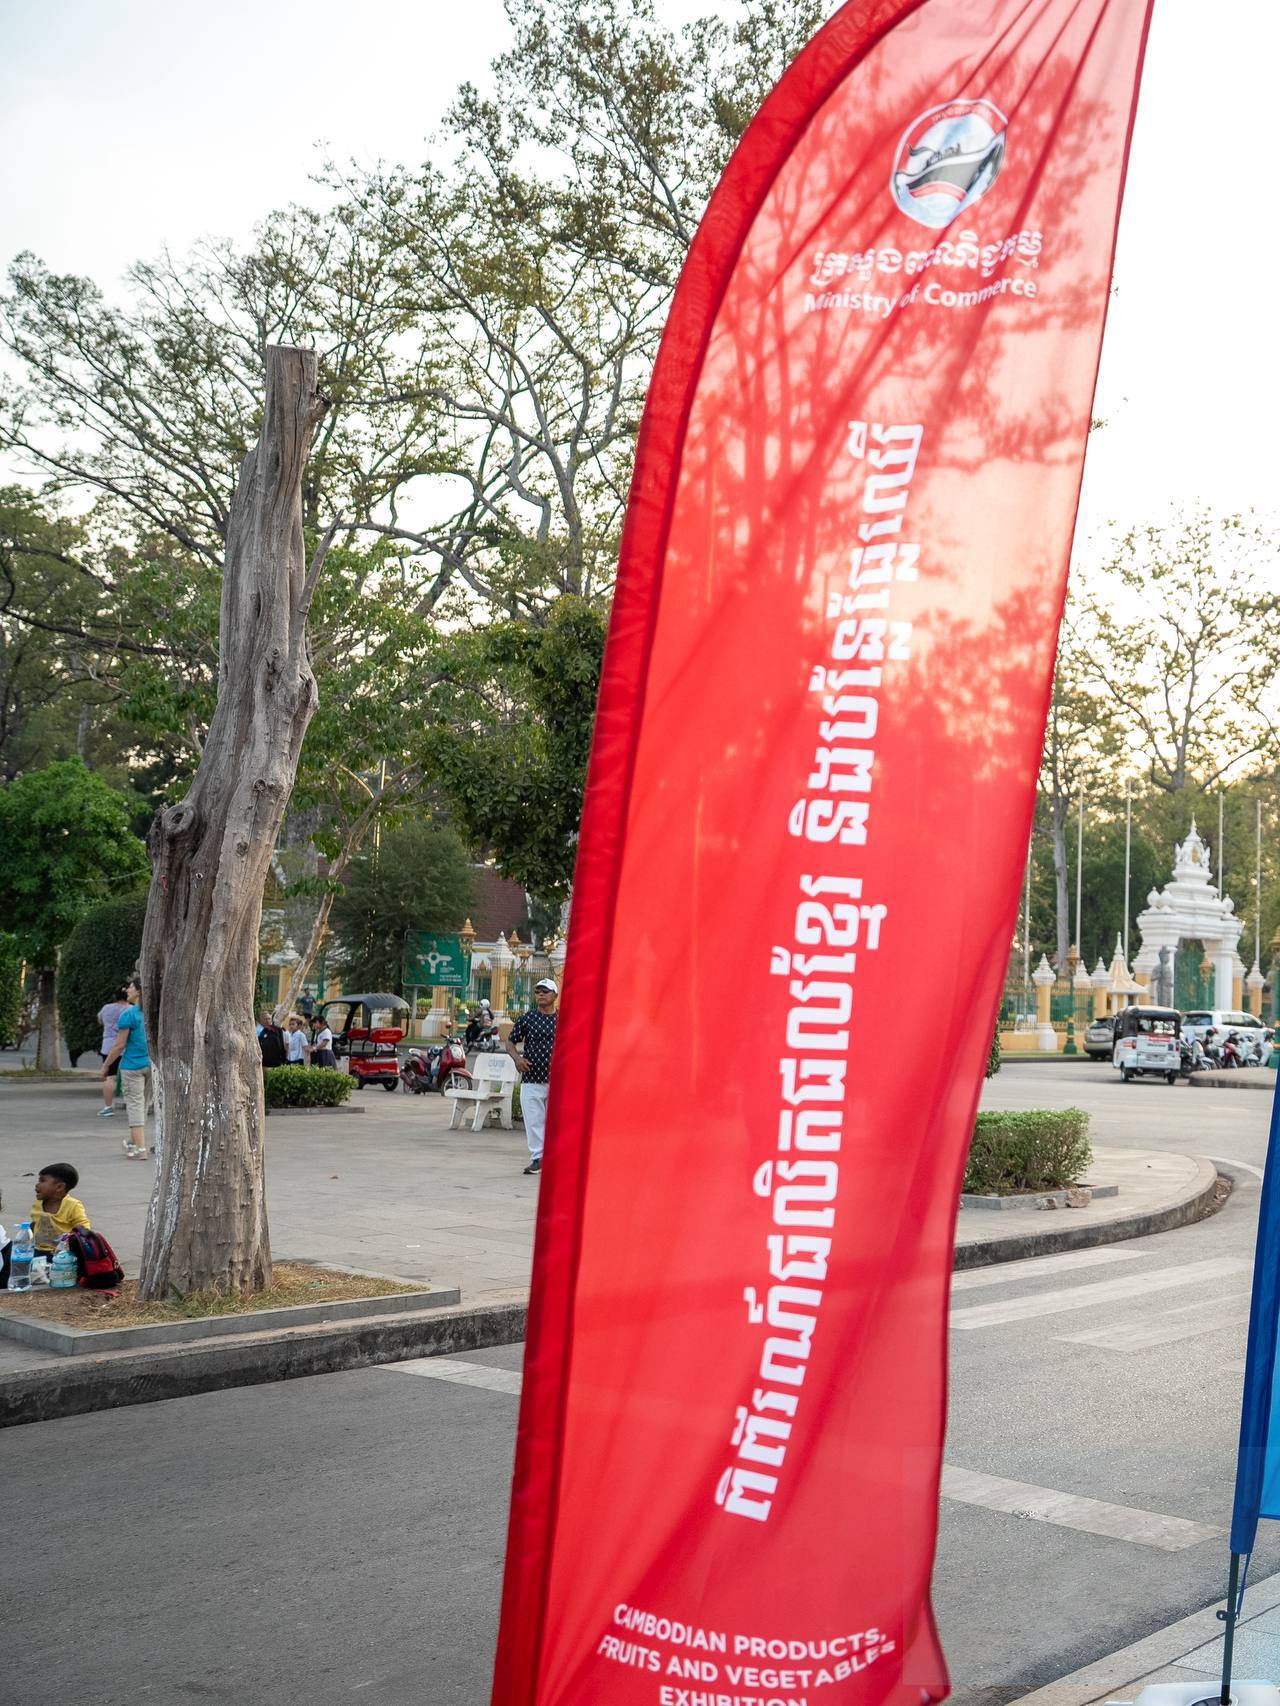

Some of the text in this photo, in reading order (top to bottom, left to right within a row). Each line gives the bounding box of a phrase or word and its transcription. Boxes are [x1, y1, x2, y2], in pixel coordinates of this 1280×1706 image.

[803, 279, 1038, 319] Ministry of Commerce
[614, 1604, 887, 1660] CAMBODIAN PRODUCTS,
[597, 1635, 896, 1689] FRUITS AND VEGETABLES
